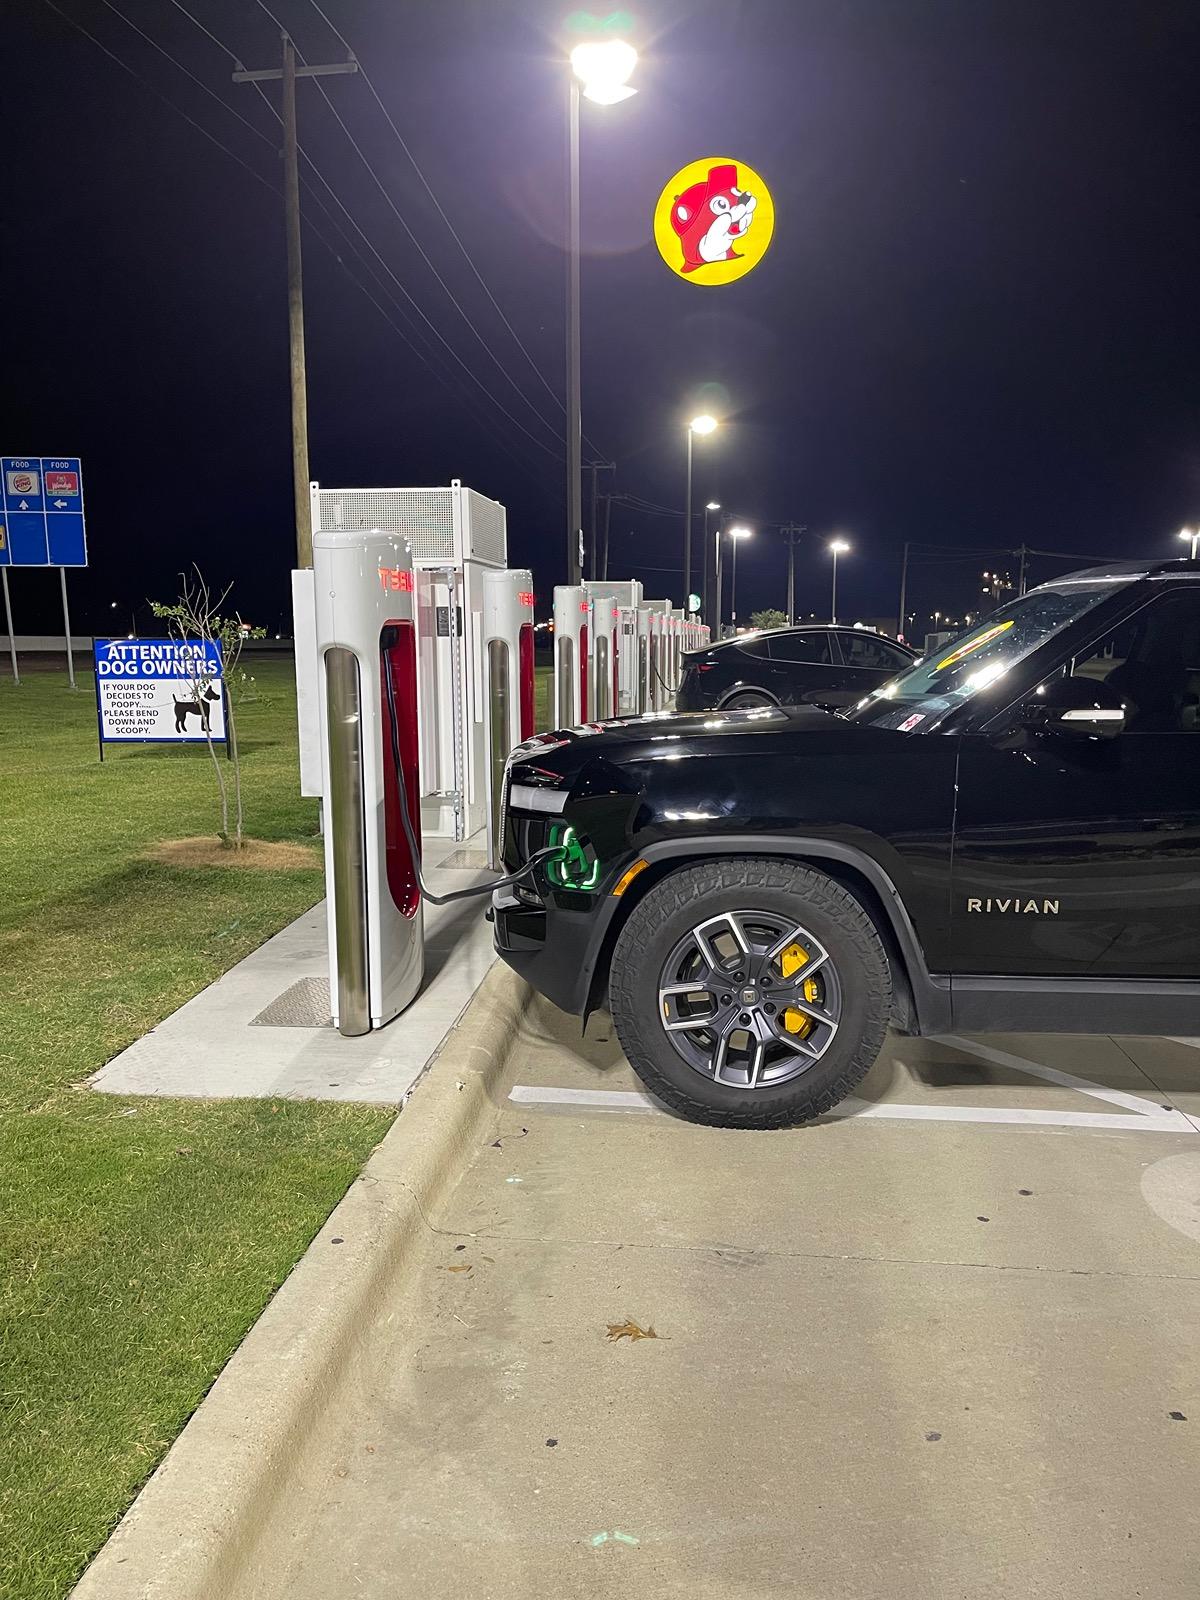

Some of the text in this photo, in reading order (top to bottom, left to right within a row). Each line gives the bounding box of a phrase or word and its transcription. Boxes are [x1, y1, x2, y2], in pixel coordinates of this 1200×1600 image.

[378, 568, 414, 593] TESL
[108, 645, 206, 660] ATTENTION
[98, 660, 218, 675] DOG OWNERS
[103, 683, 156, 691] IF YOUR DOG
[106, 692, 154, 700] DECIDES TO
[967, 898, 1060, 914] RIVIAN
